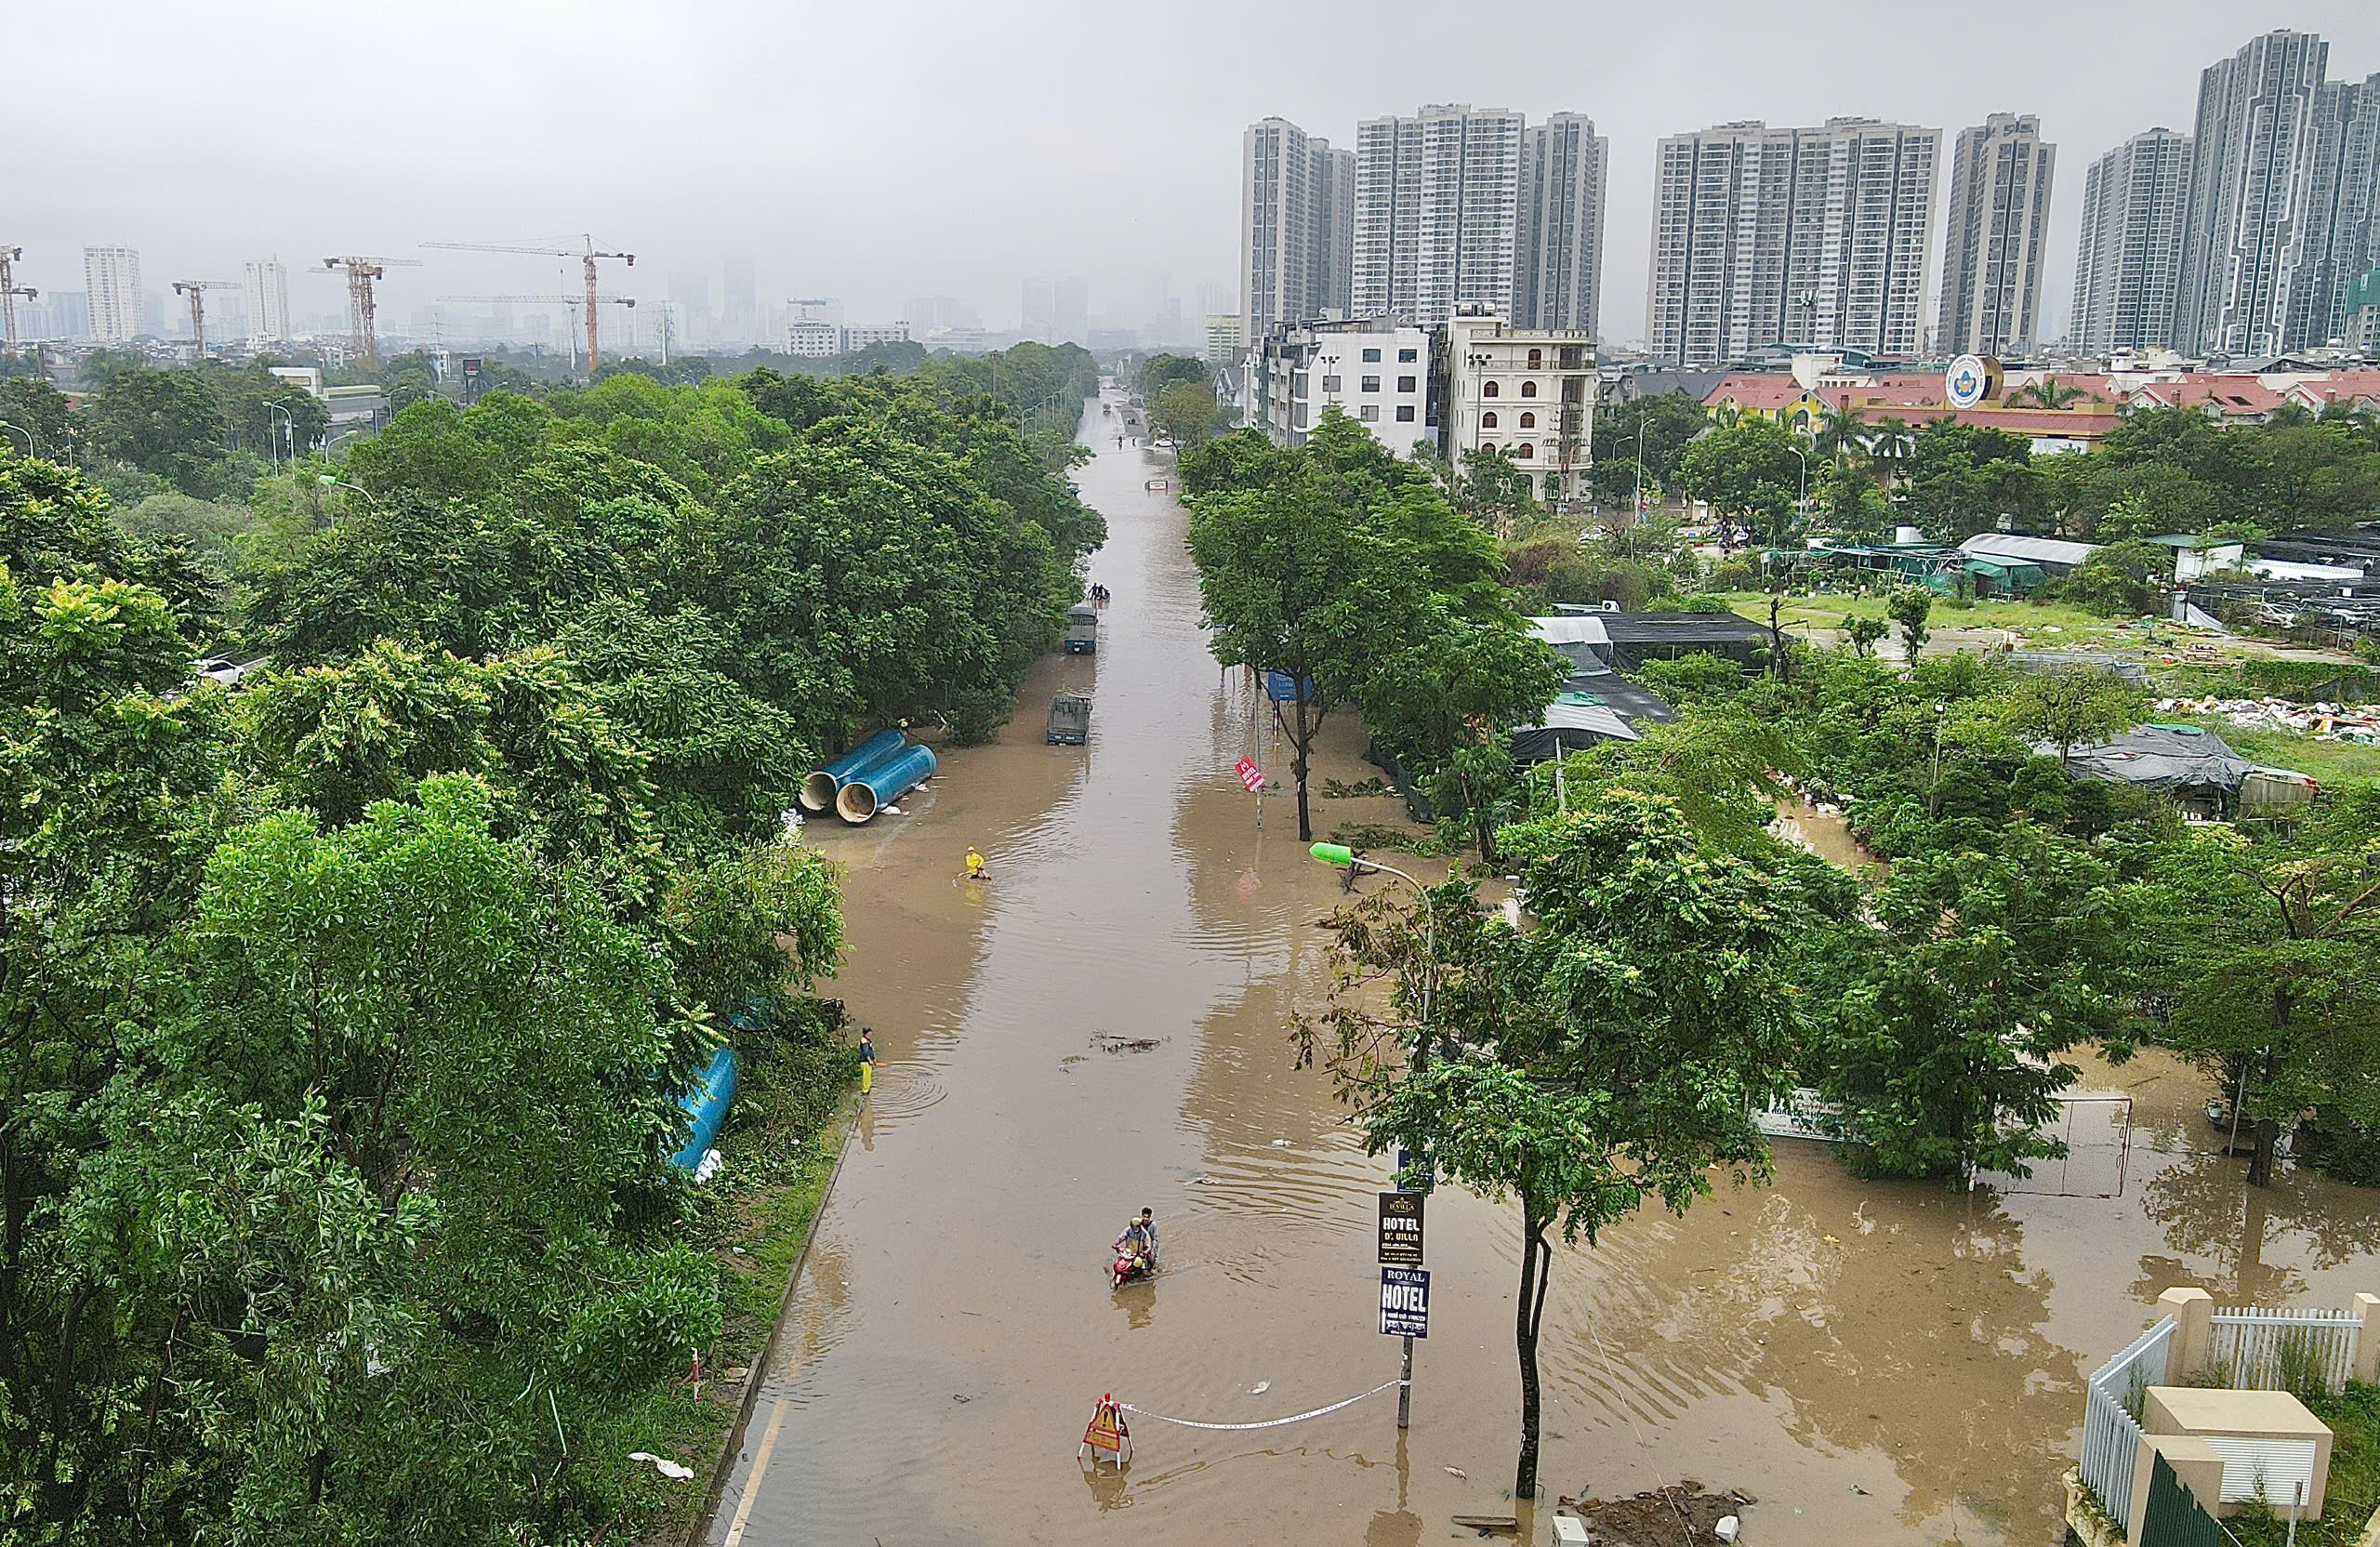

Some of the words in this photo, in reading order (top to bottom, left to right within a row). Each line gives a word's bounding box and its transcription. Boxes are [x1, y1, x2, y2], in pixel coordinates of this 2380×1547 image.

[1382, 1217, 1421, 1232] HOTEL
[1387, 1269, 1425, 1283] ROYAL
[1382, 1284, 1426, 1313] HOTEL
